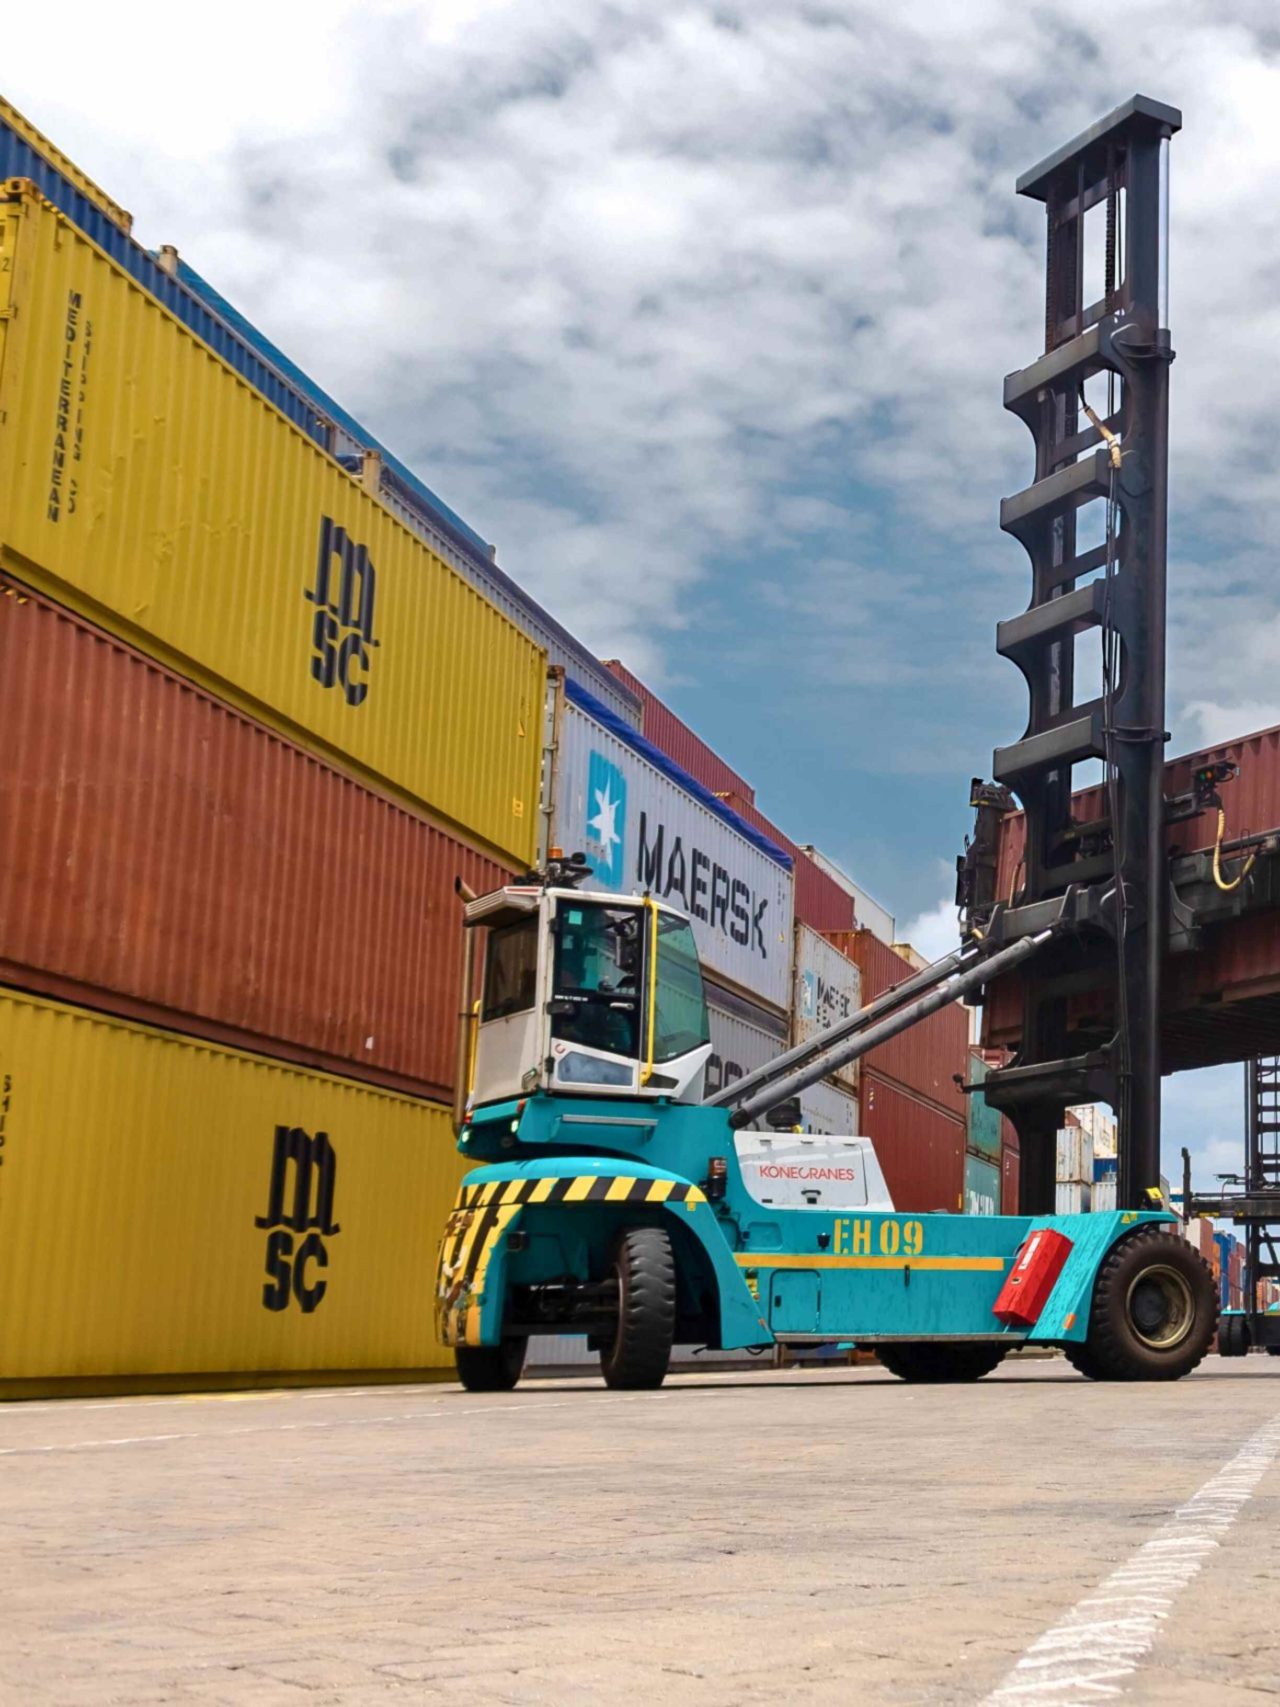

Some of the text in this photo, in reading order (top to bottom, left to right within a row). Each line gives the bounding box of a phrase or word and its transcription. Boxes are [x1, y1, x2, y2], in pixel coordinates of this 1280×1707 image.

[47, 289, 81, 523] MEDITERRANEAN
[637, 811, 768, 959] MAERSK
[759, 1165, 855, 1181] KONECRANES
[834, 1218, 924, 1255] EH 09
